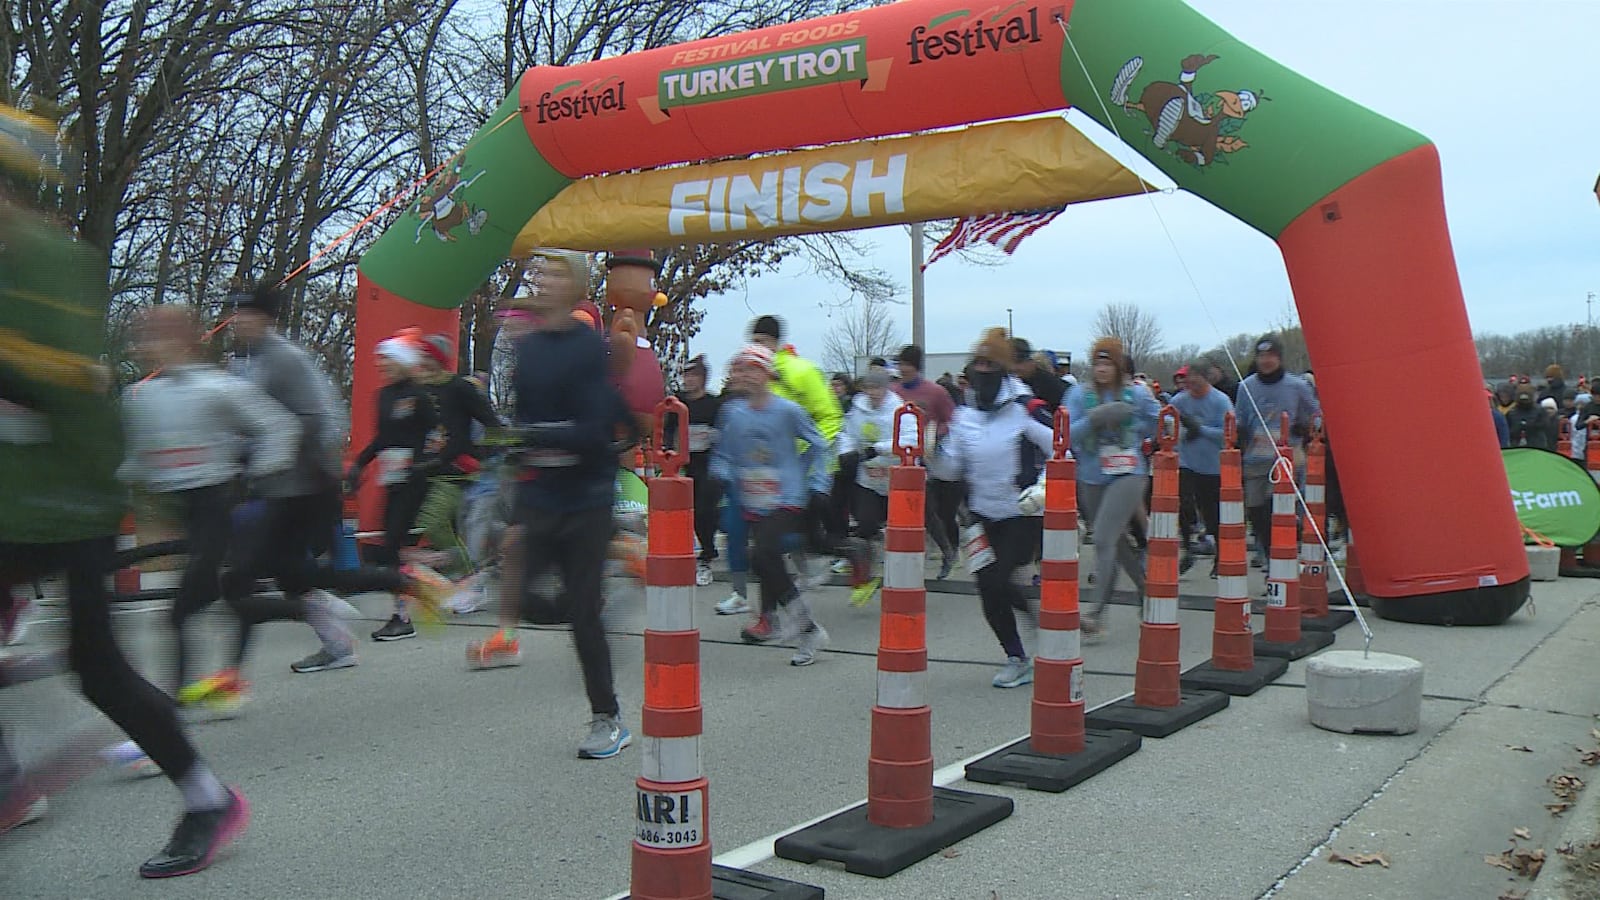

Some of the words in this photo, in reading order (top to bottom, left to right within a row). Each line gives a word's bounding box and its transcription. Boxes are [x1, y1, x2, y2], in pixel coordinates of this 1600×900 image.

[671, 36, 771, 65] FESTIVAL
[777, 19, 860, 47] FOODS
[906, 6, 1041, 65] festival
[663, 58, 775, 100] TURKEY
[779, 44, 861, 82] TROT
[536, 81, 626, 124] festival
[668, 153, 907, 236] FINISH
